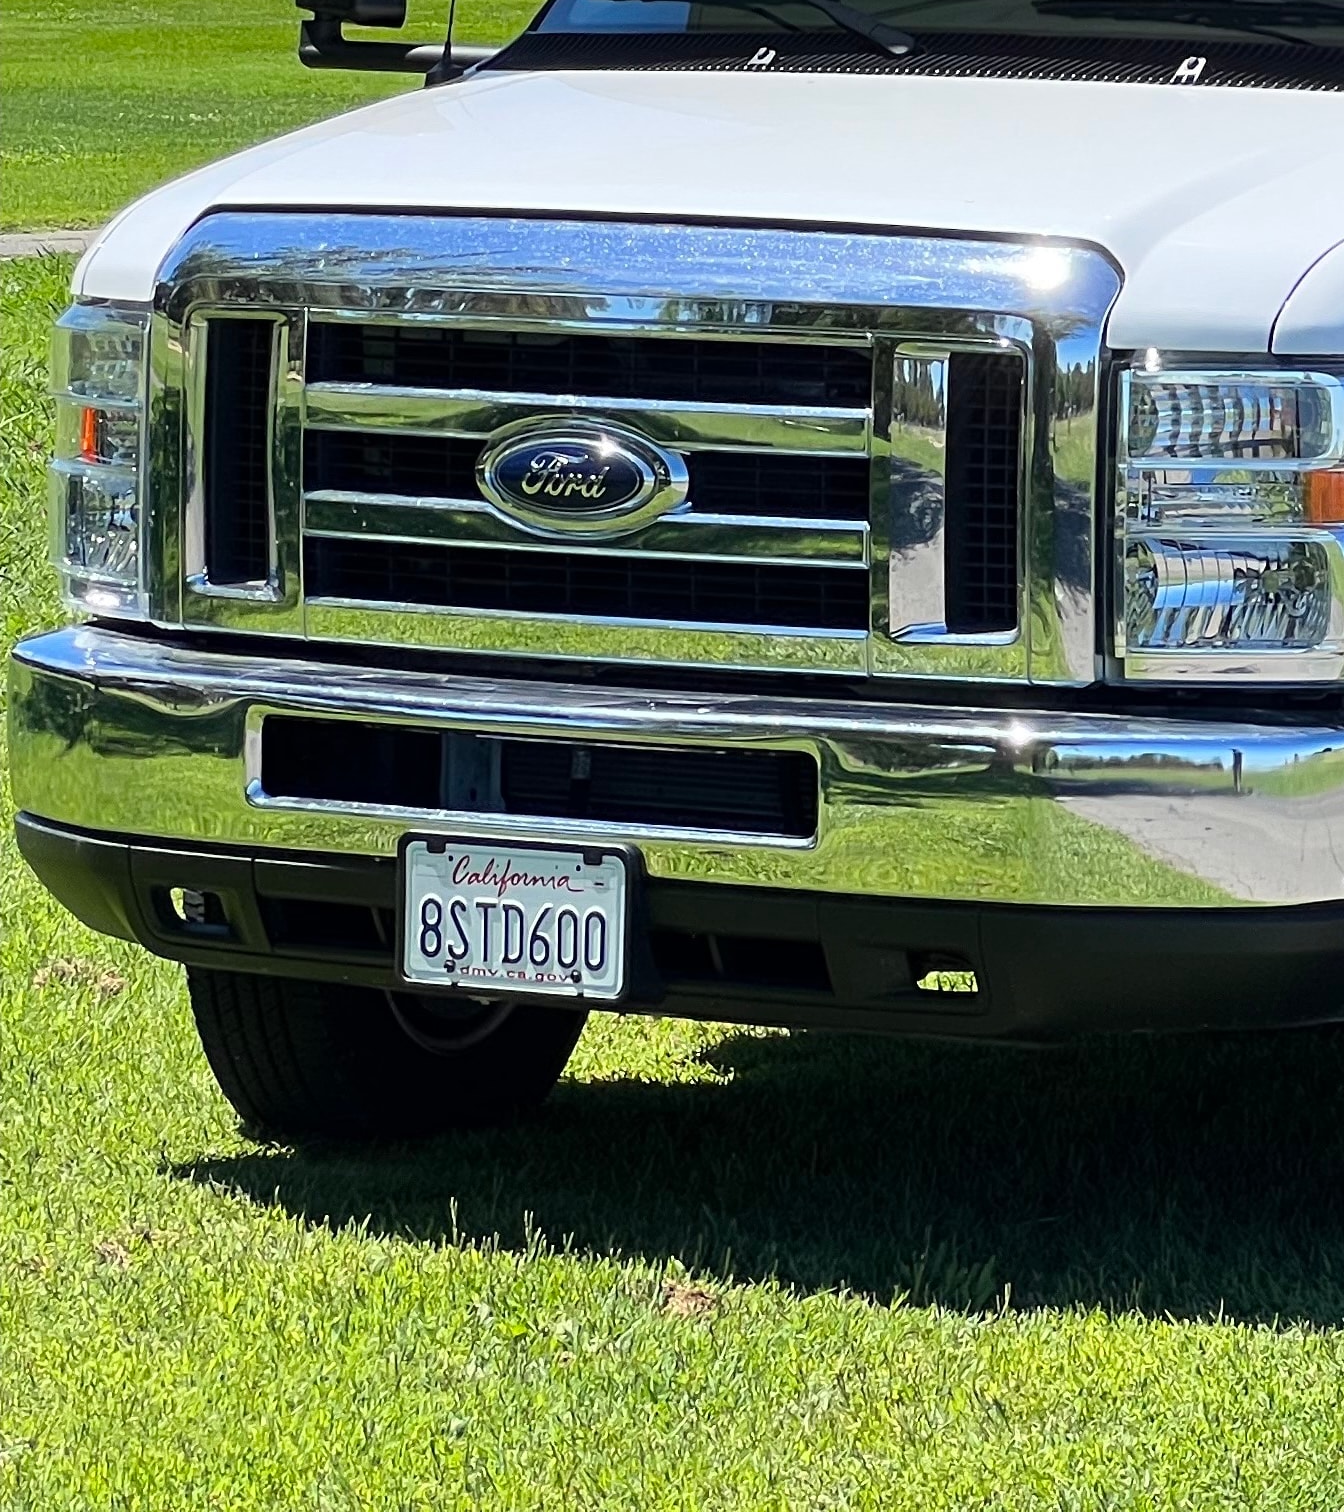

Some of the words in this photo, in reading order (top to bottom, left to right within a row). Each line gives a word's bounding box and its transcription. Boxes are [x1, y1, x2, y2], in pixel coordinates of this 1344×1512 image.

[521, 451, 611, 499] Ford
[452, 854, 585, 897] California
[419, 897, 606, 972] 8STD600
[460, 965, 574, 983] dmv.ca.gov
